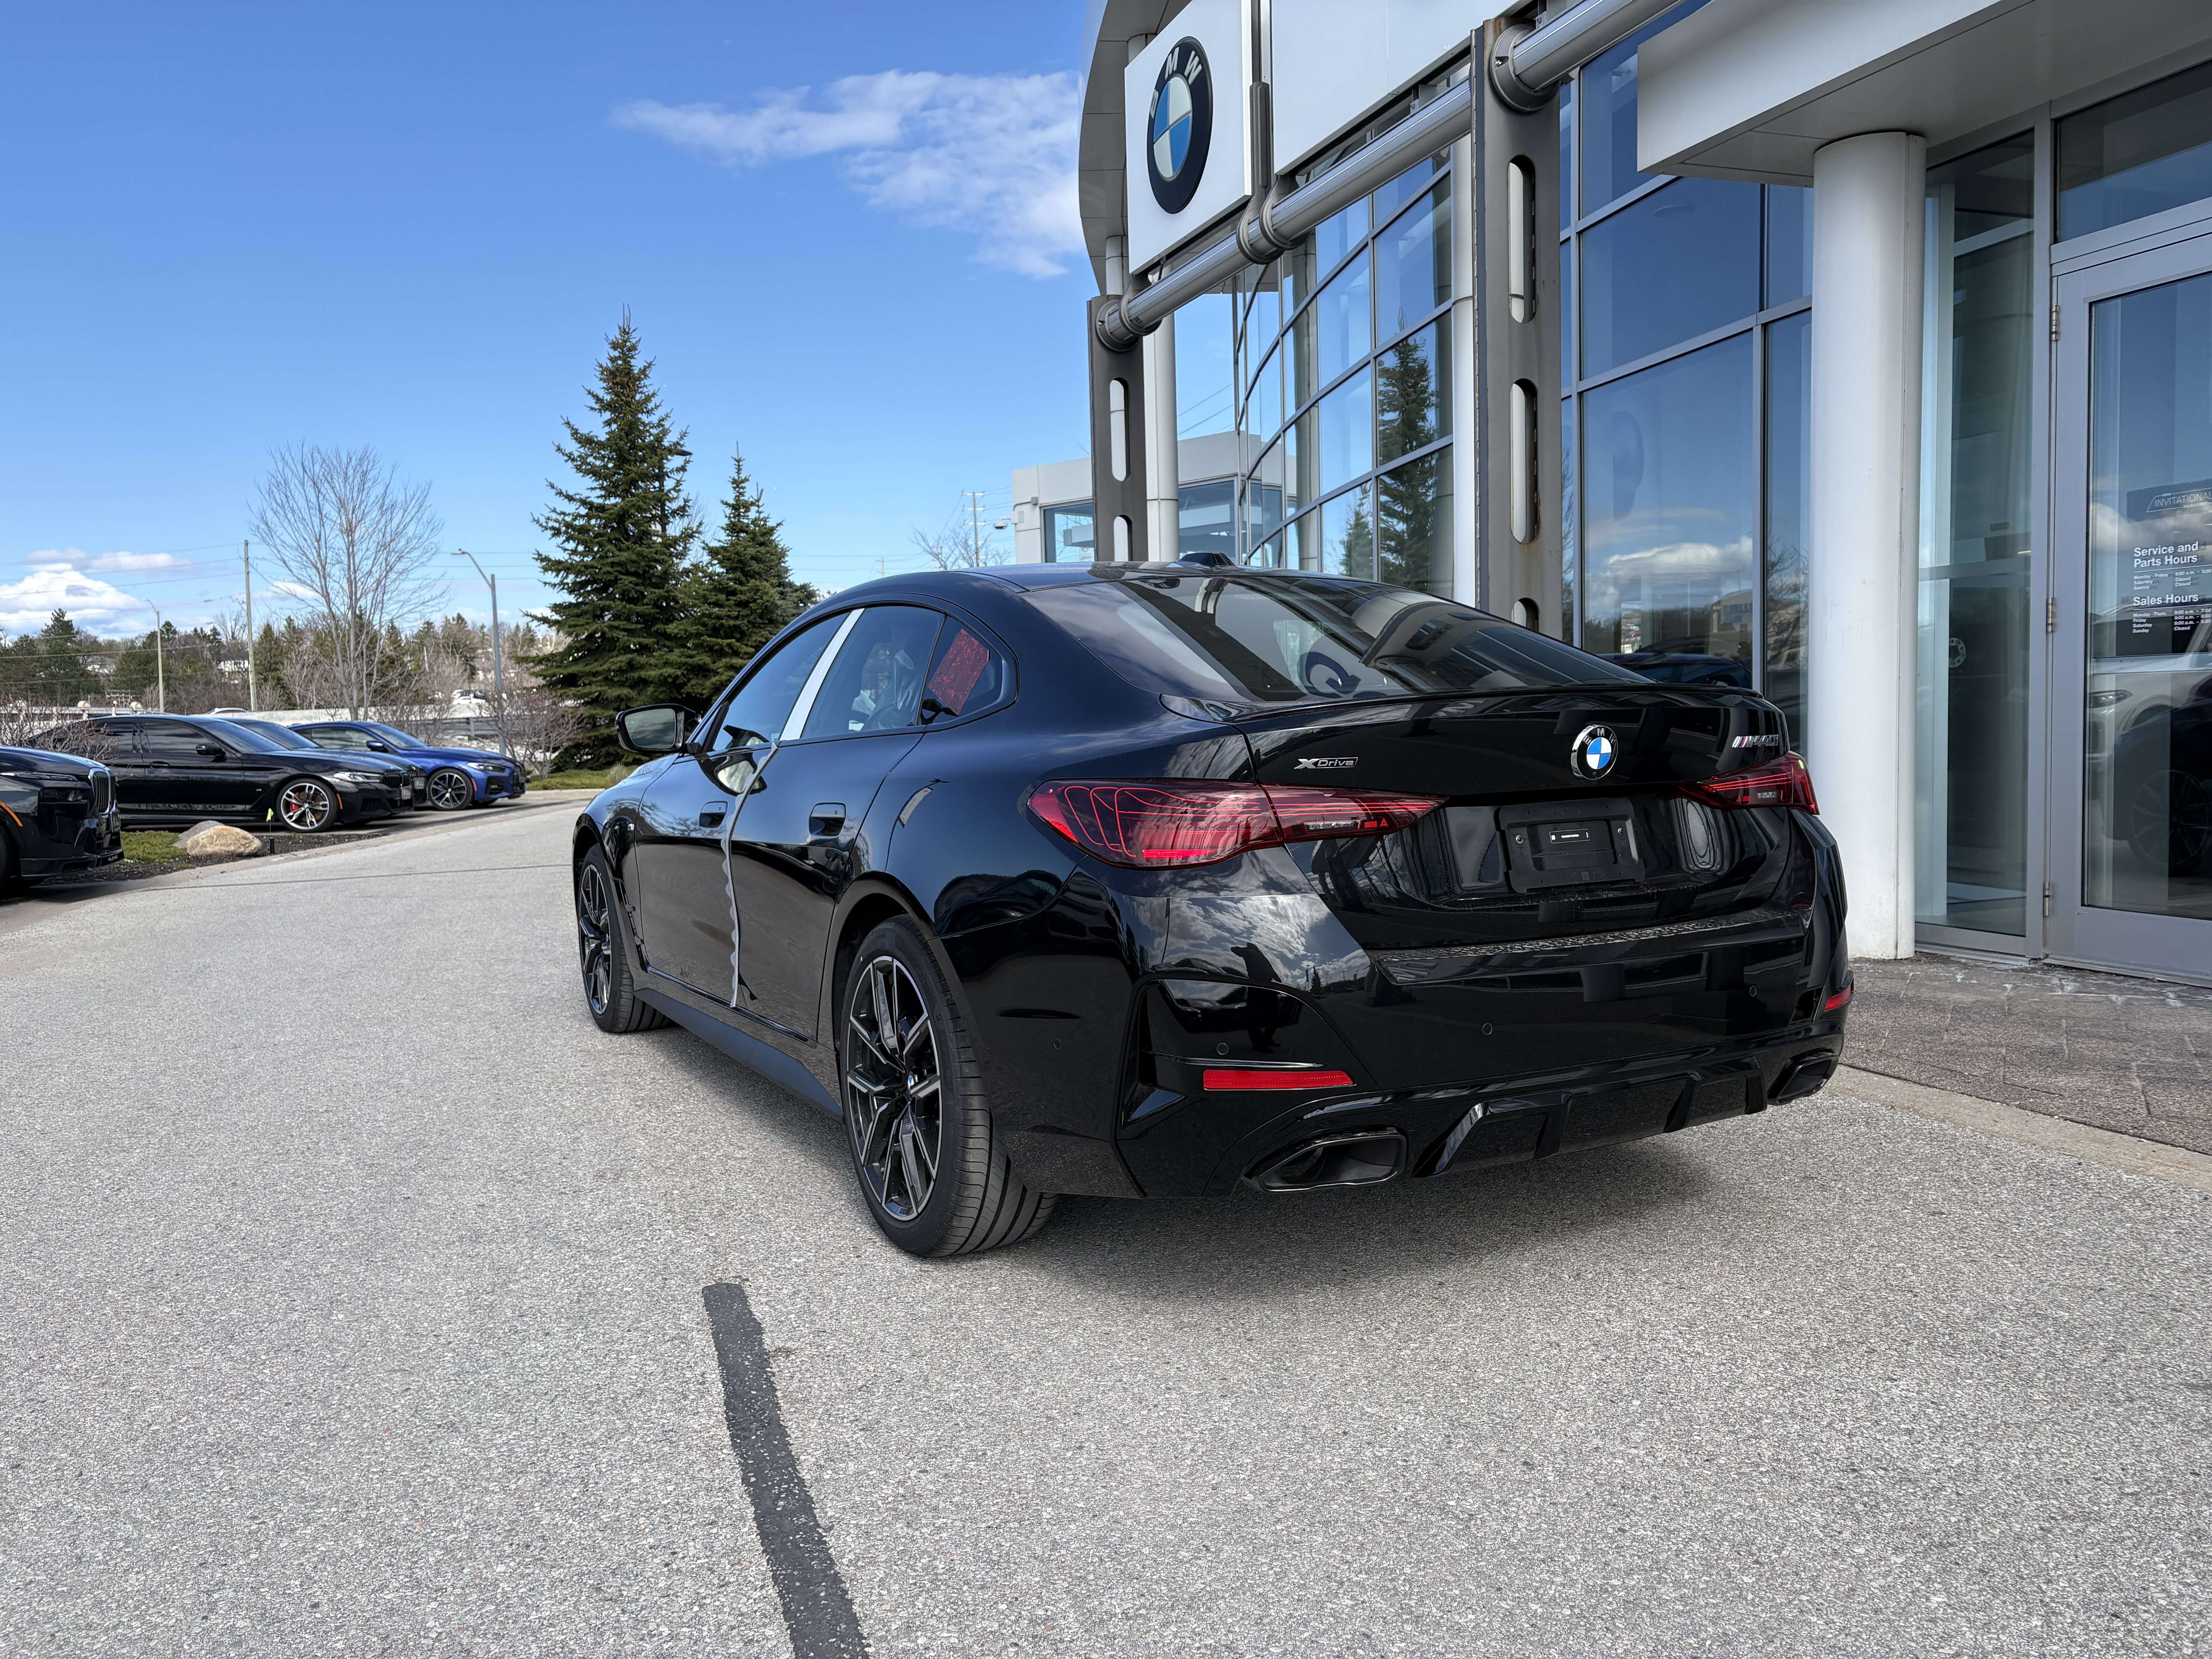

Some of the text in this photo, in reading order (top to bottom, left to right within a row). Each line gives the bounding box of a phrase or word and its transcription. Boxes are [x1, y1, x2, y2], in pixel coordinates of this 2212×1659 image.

[1151, 47, 1202, 118] BMW
[2155, 491, 2212, 507] INVITATIONAL
[2134, 541, 2199, 557] Service and
[2134, 555, 2198, 568] Parts Hours
[2133, 594, 2199, 606] Sales Hours
[1583, 728, 1616, 745] BMW
